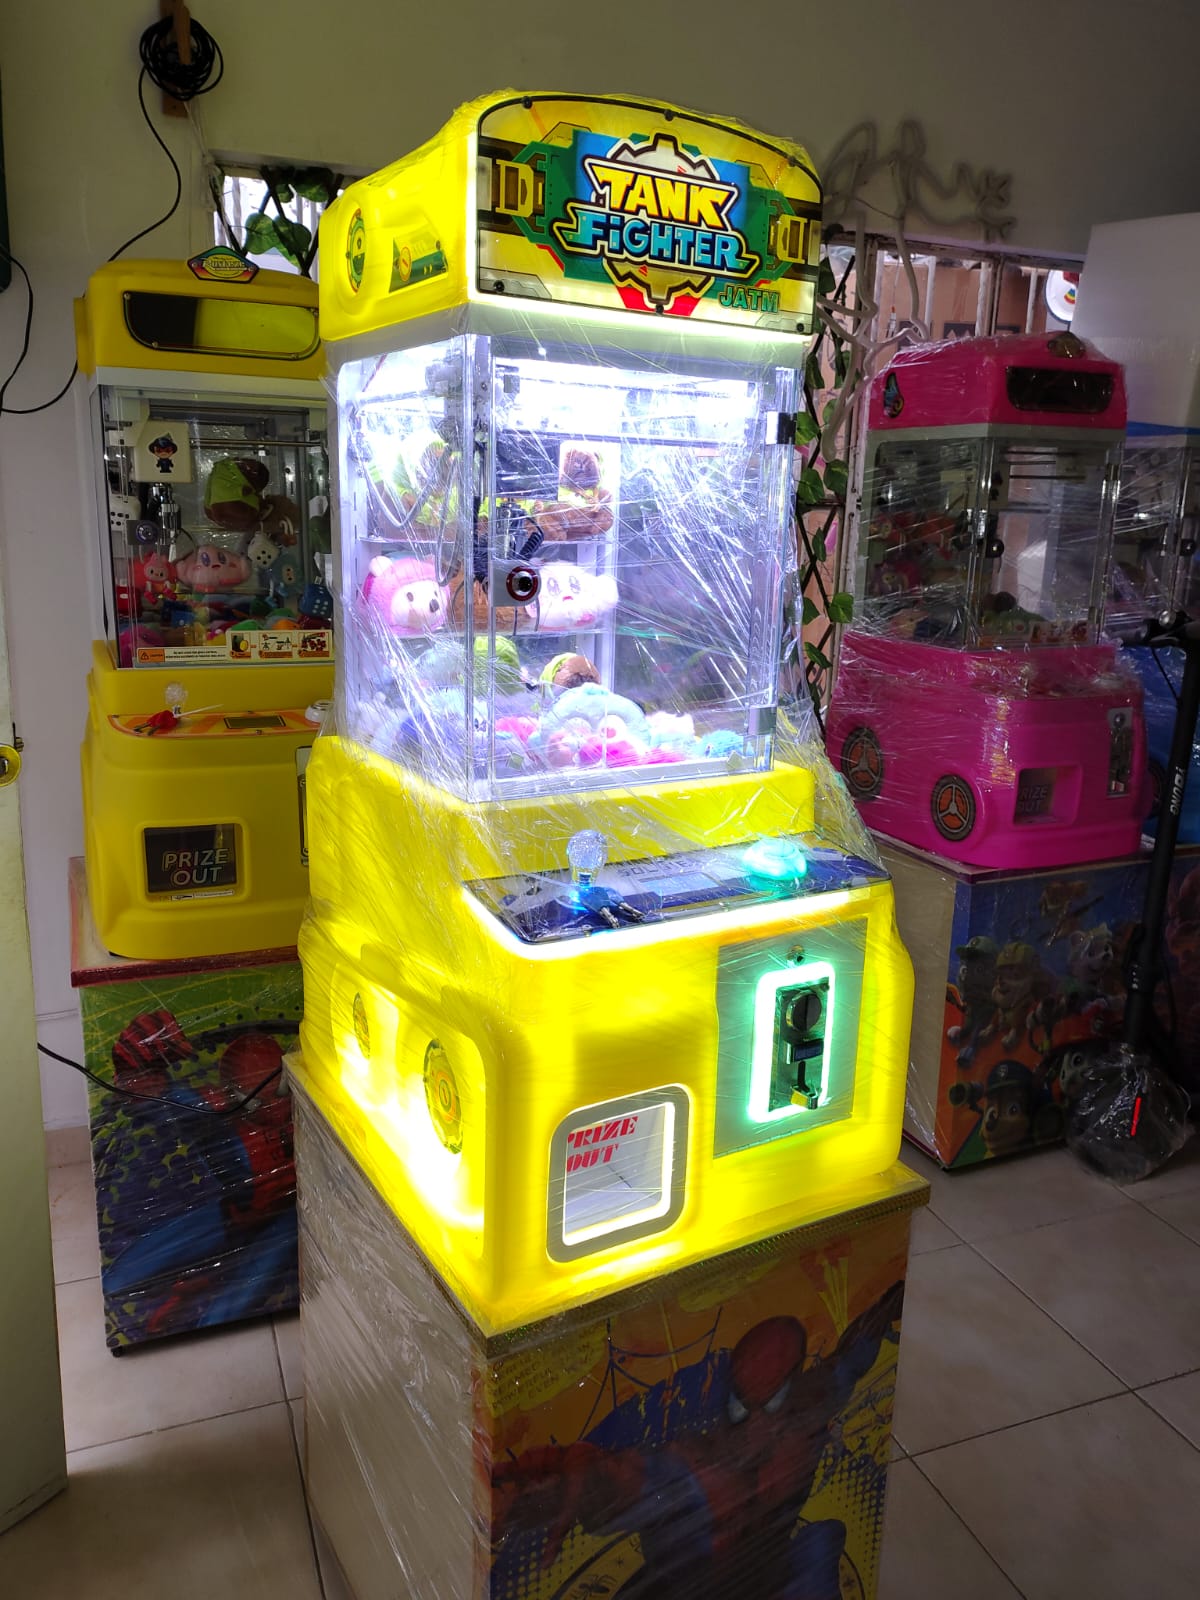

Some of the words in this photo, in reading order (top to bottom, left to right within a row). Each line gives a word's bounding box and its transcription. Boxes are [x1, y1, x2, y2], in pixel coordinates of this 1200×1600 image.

[589, 162, 734, 229] TANK
[719, 285, 779, 314] JATM
[163, 848, 229, 869] PRIZE
[173, 866, 222, 885] OUT
[566, 1143, 619, 1173] OUT
